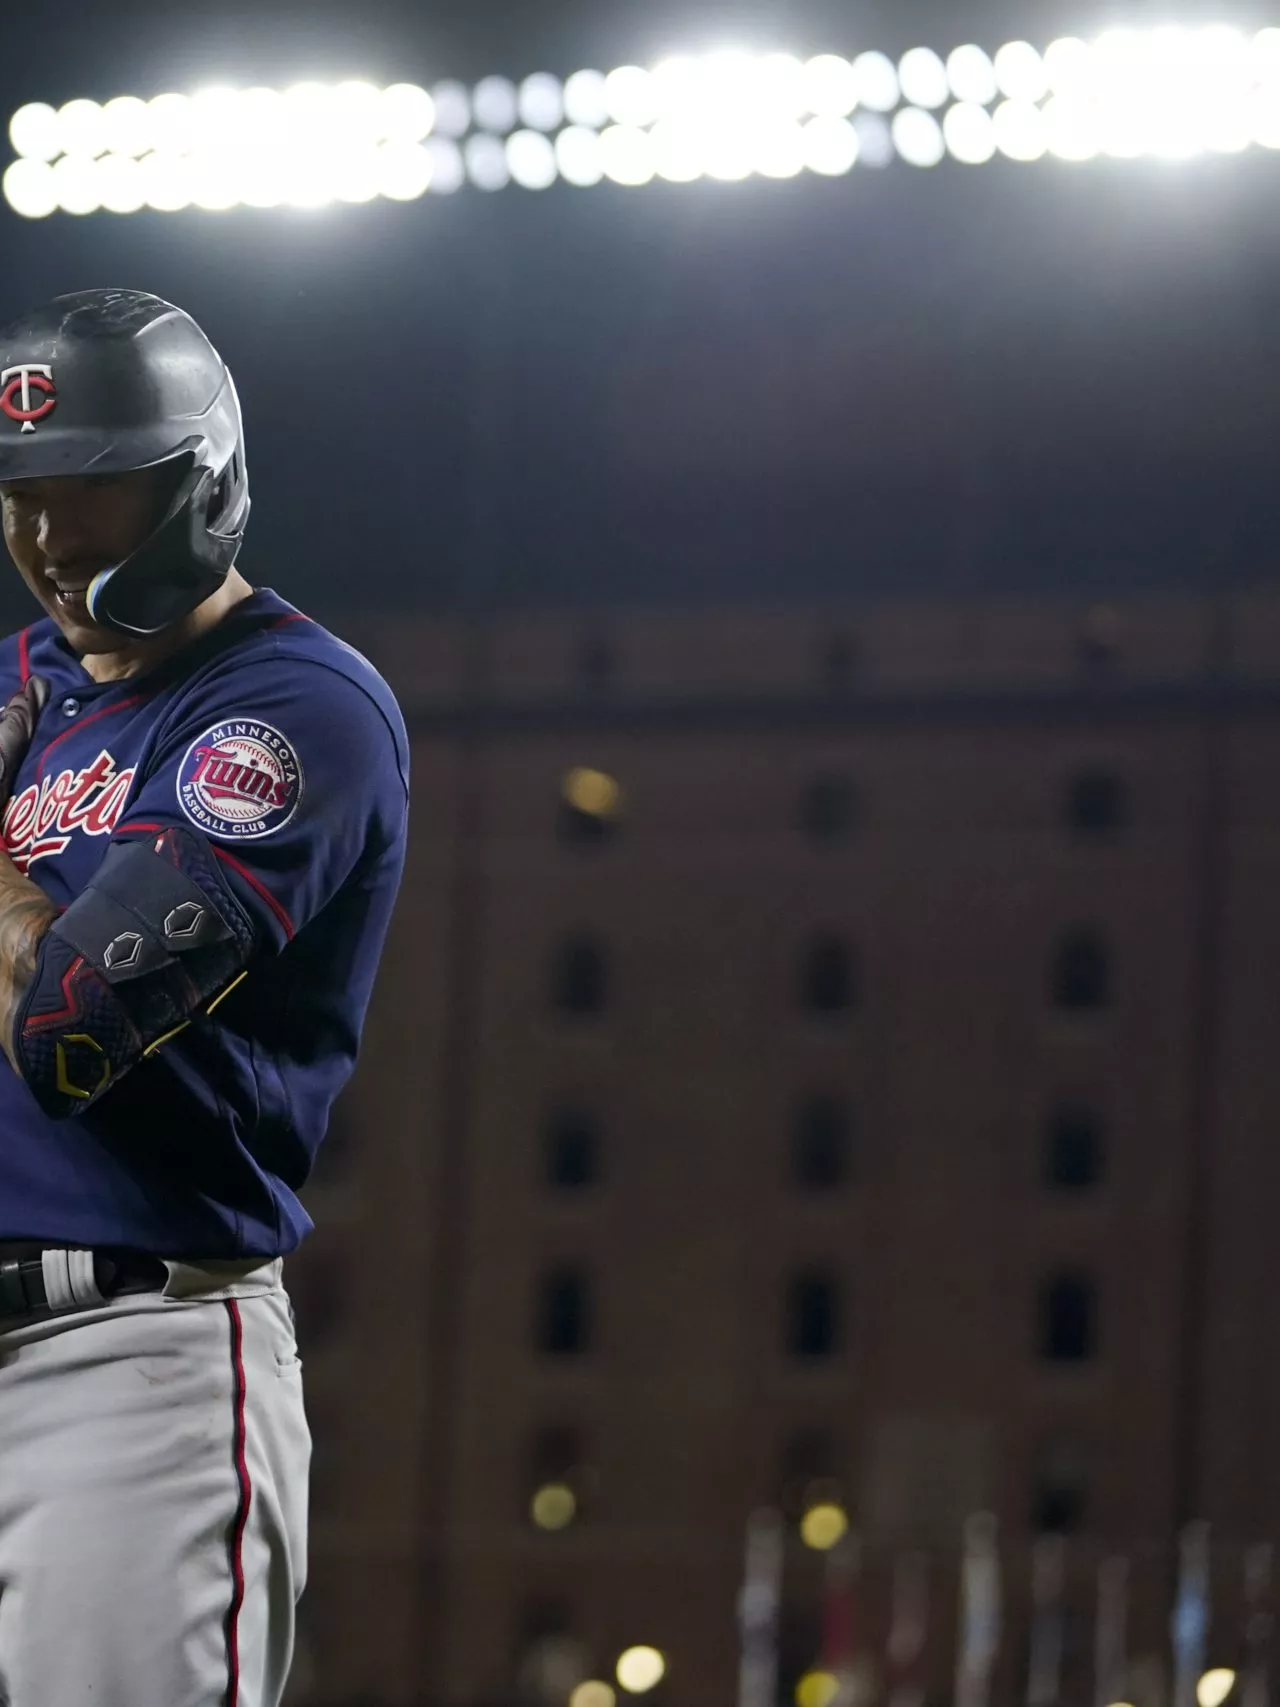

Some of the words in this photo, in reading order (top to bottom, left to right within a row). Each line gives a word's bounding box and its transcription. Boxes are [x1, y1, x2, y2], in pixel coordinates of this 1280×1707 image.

[188, 744, 289, 808] Twins
[212, 724, 296, 784] MINNESOTA
[182, 784, 227, 832] BASEBALL
[232, 820, 267, 833] CLUB
